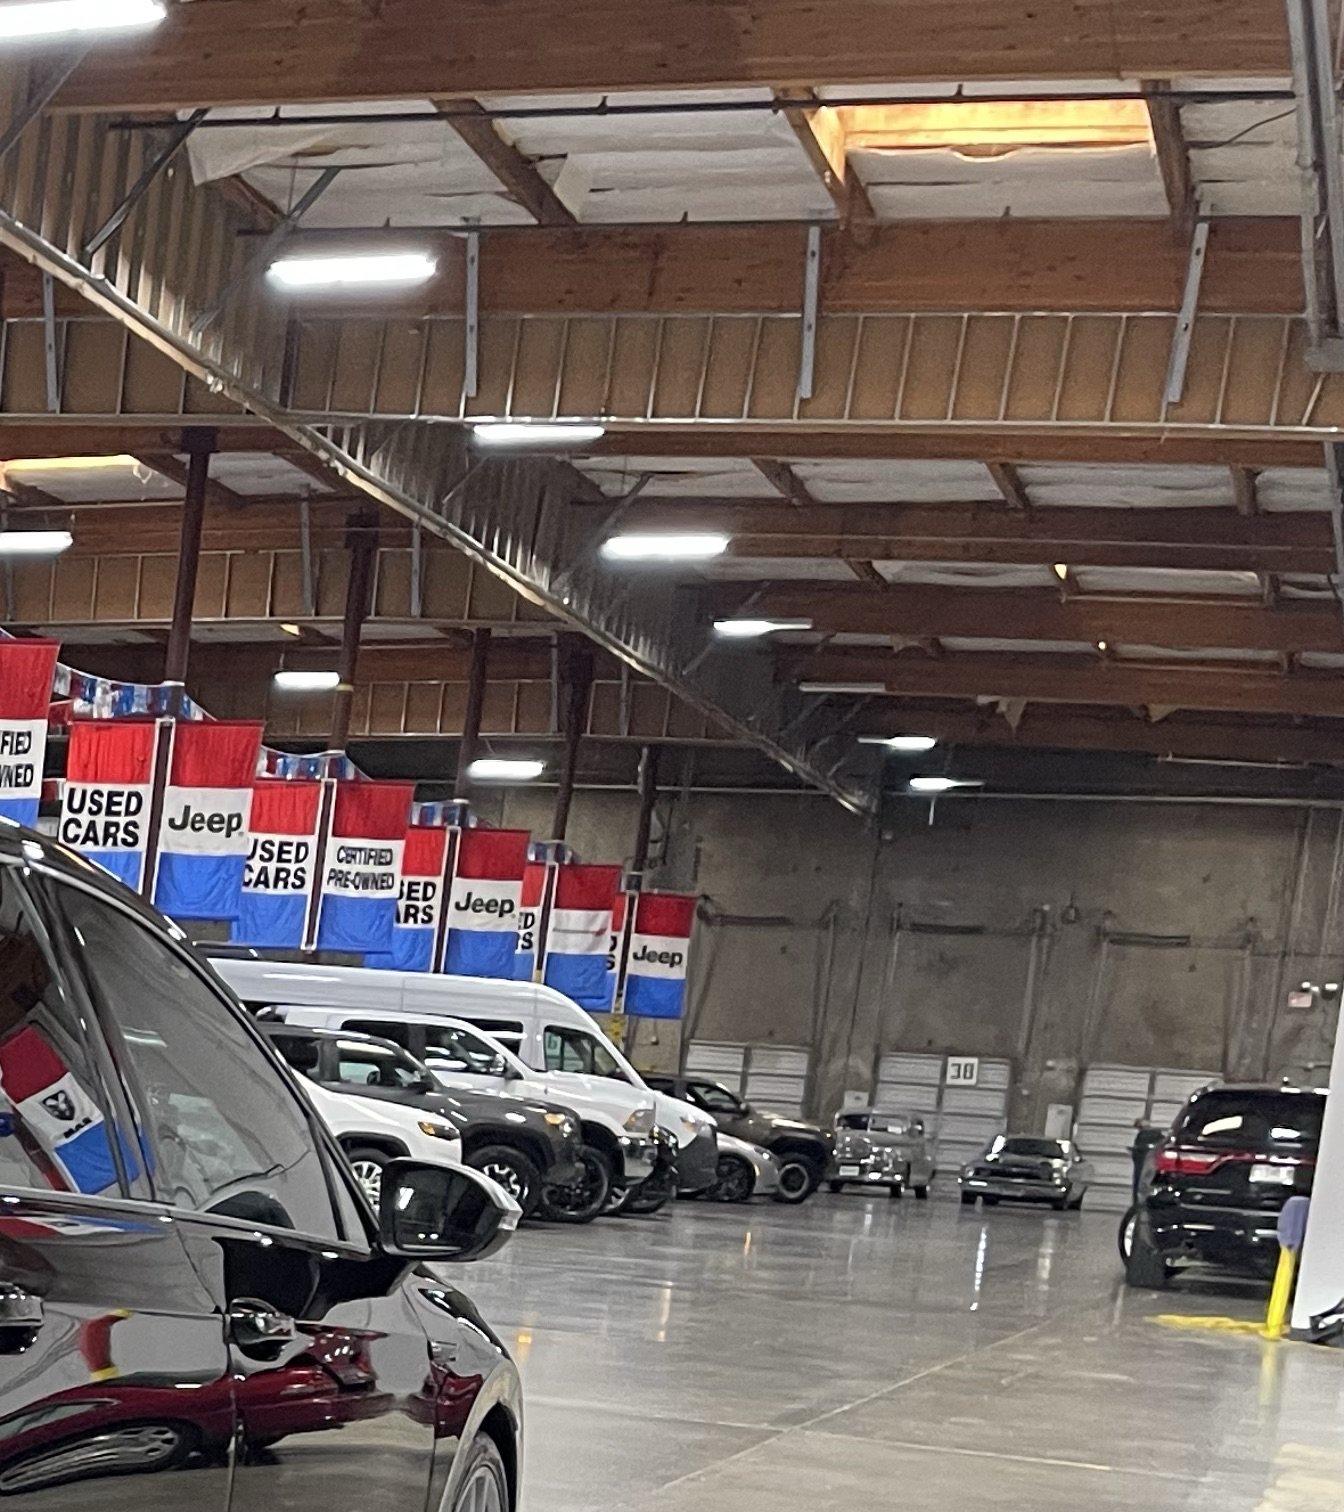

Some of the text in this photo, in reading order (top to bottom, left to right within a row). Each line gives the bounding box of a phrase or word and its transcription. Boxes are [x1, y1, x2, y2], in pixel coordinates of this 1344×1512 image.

[66, 788, 143, 817] USED
[62, 818, 140, 848] CARS
[168, 805, 244, 839] Jeep
[336, 845, 394, 867] CERTIFIED
[398, 880, 437, 902] ED
[395, 904, 434, 925] RS
[454, 892, 515, 918] Jeep
[632, 945, 683, 968] Jeep
